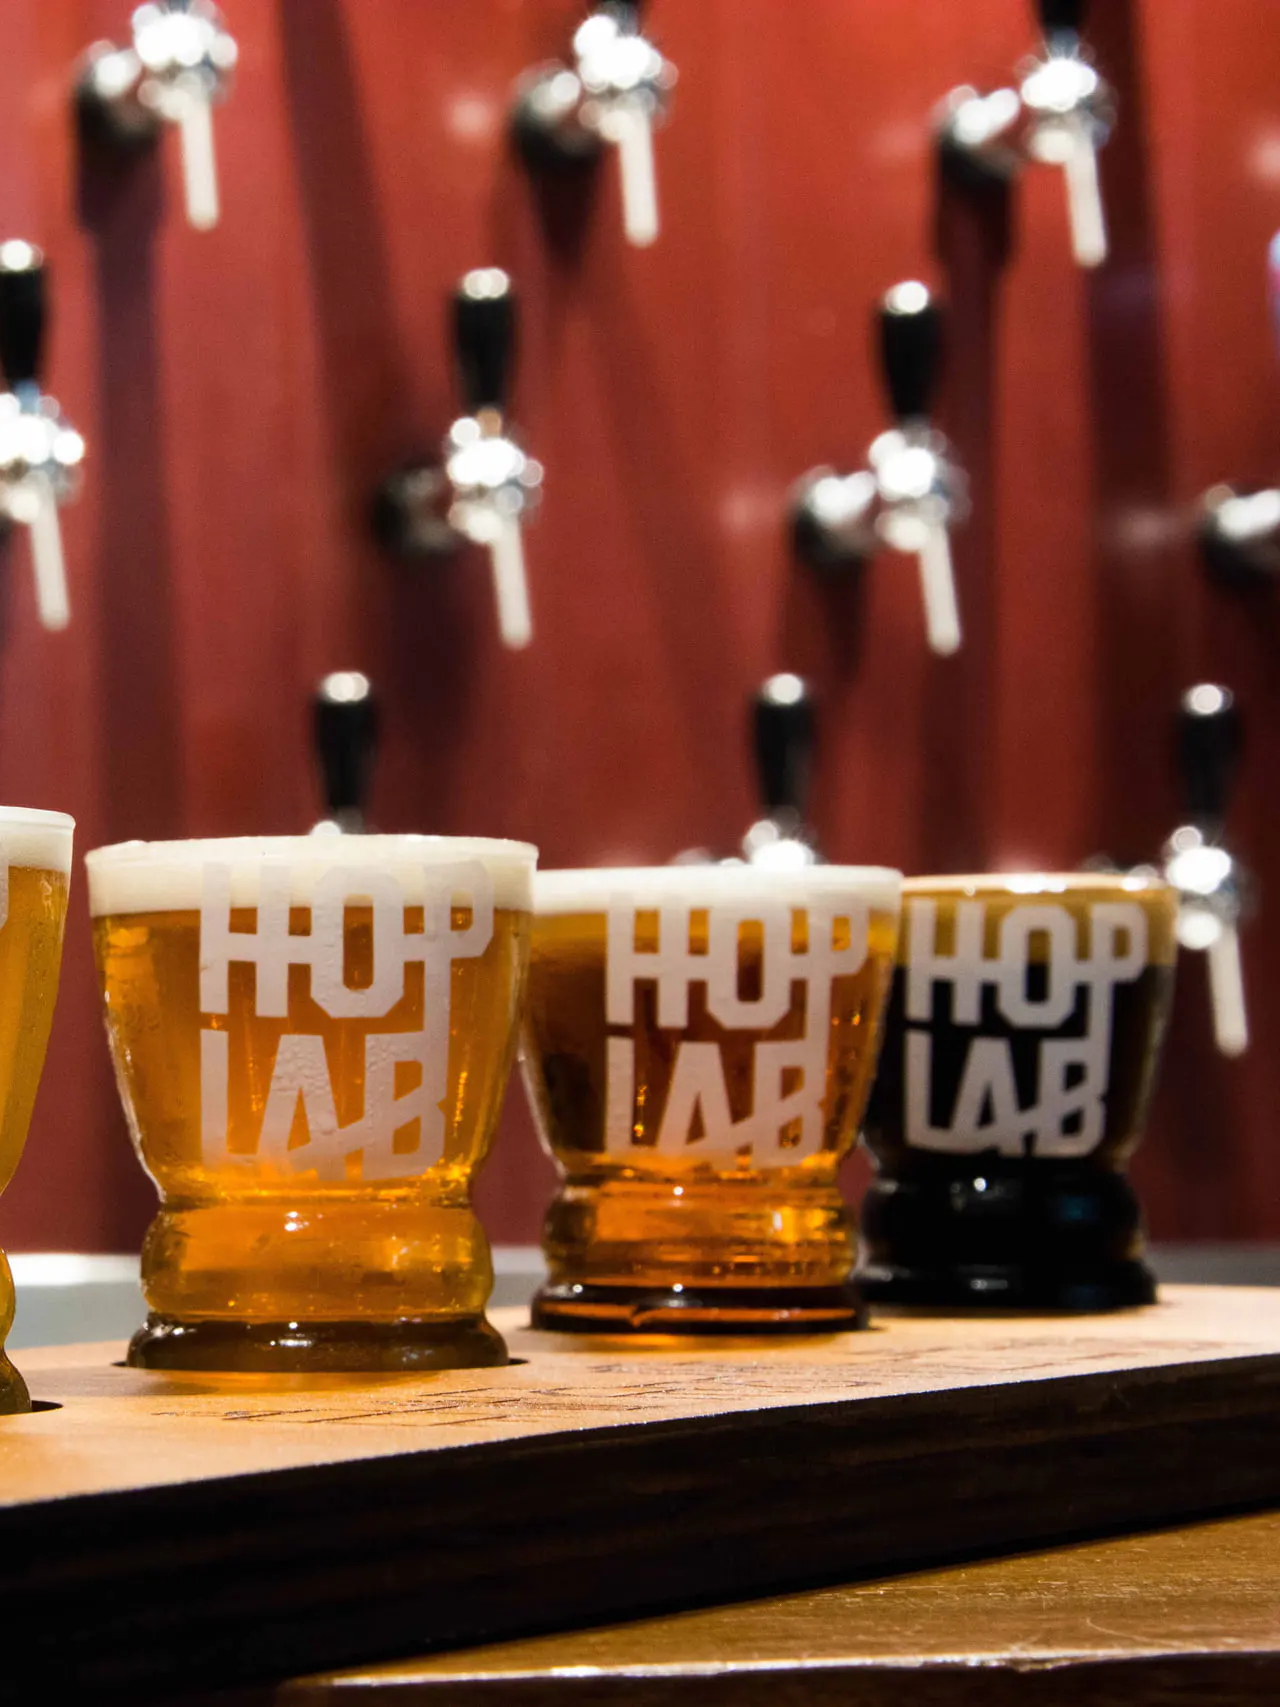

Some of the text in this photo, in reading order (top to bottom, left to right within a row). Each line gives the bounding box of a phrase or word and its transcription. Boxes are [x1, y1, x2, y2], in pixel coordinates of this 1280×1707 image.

[200, 860, 494, 1018] HOP
[606, 892, 870, 1029] HOP
[905, 898, 1148, 1028] HOP
[200, 1028, 448, 1181] LAB
[606, 1036, 830, 1169] LAB
[905, 1030, 1108, 1158] LAB
